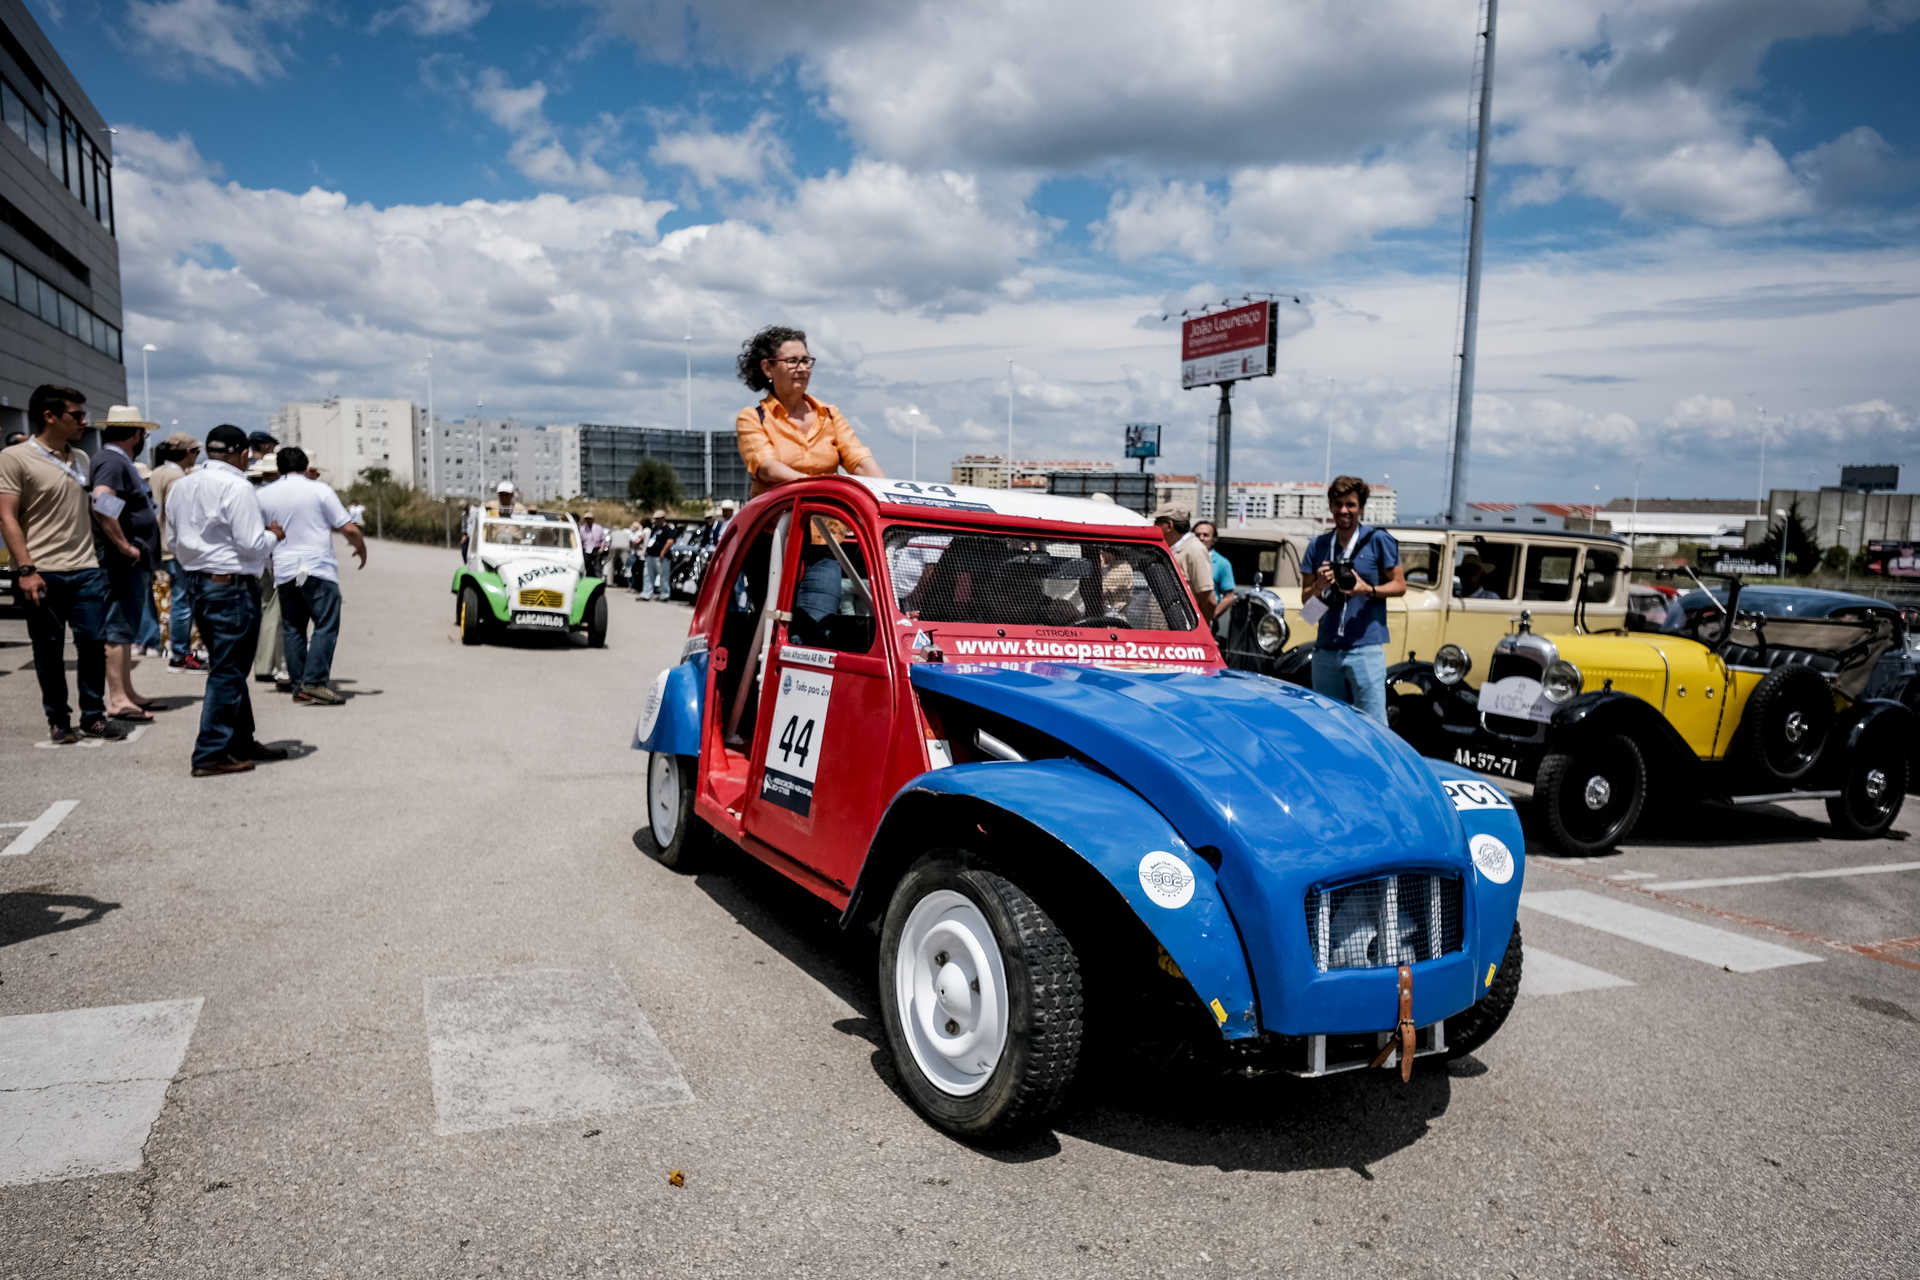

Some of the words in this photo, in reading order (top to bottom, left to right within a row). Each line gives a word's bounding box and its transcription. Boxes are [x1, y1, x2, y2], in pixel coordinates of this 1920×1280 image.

[1214, 310, 1261, 331] Lourenço
[778, 714, 815, 768] 44
[1454, 748, 1517, 776] AA-57-71
